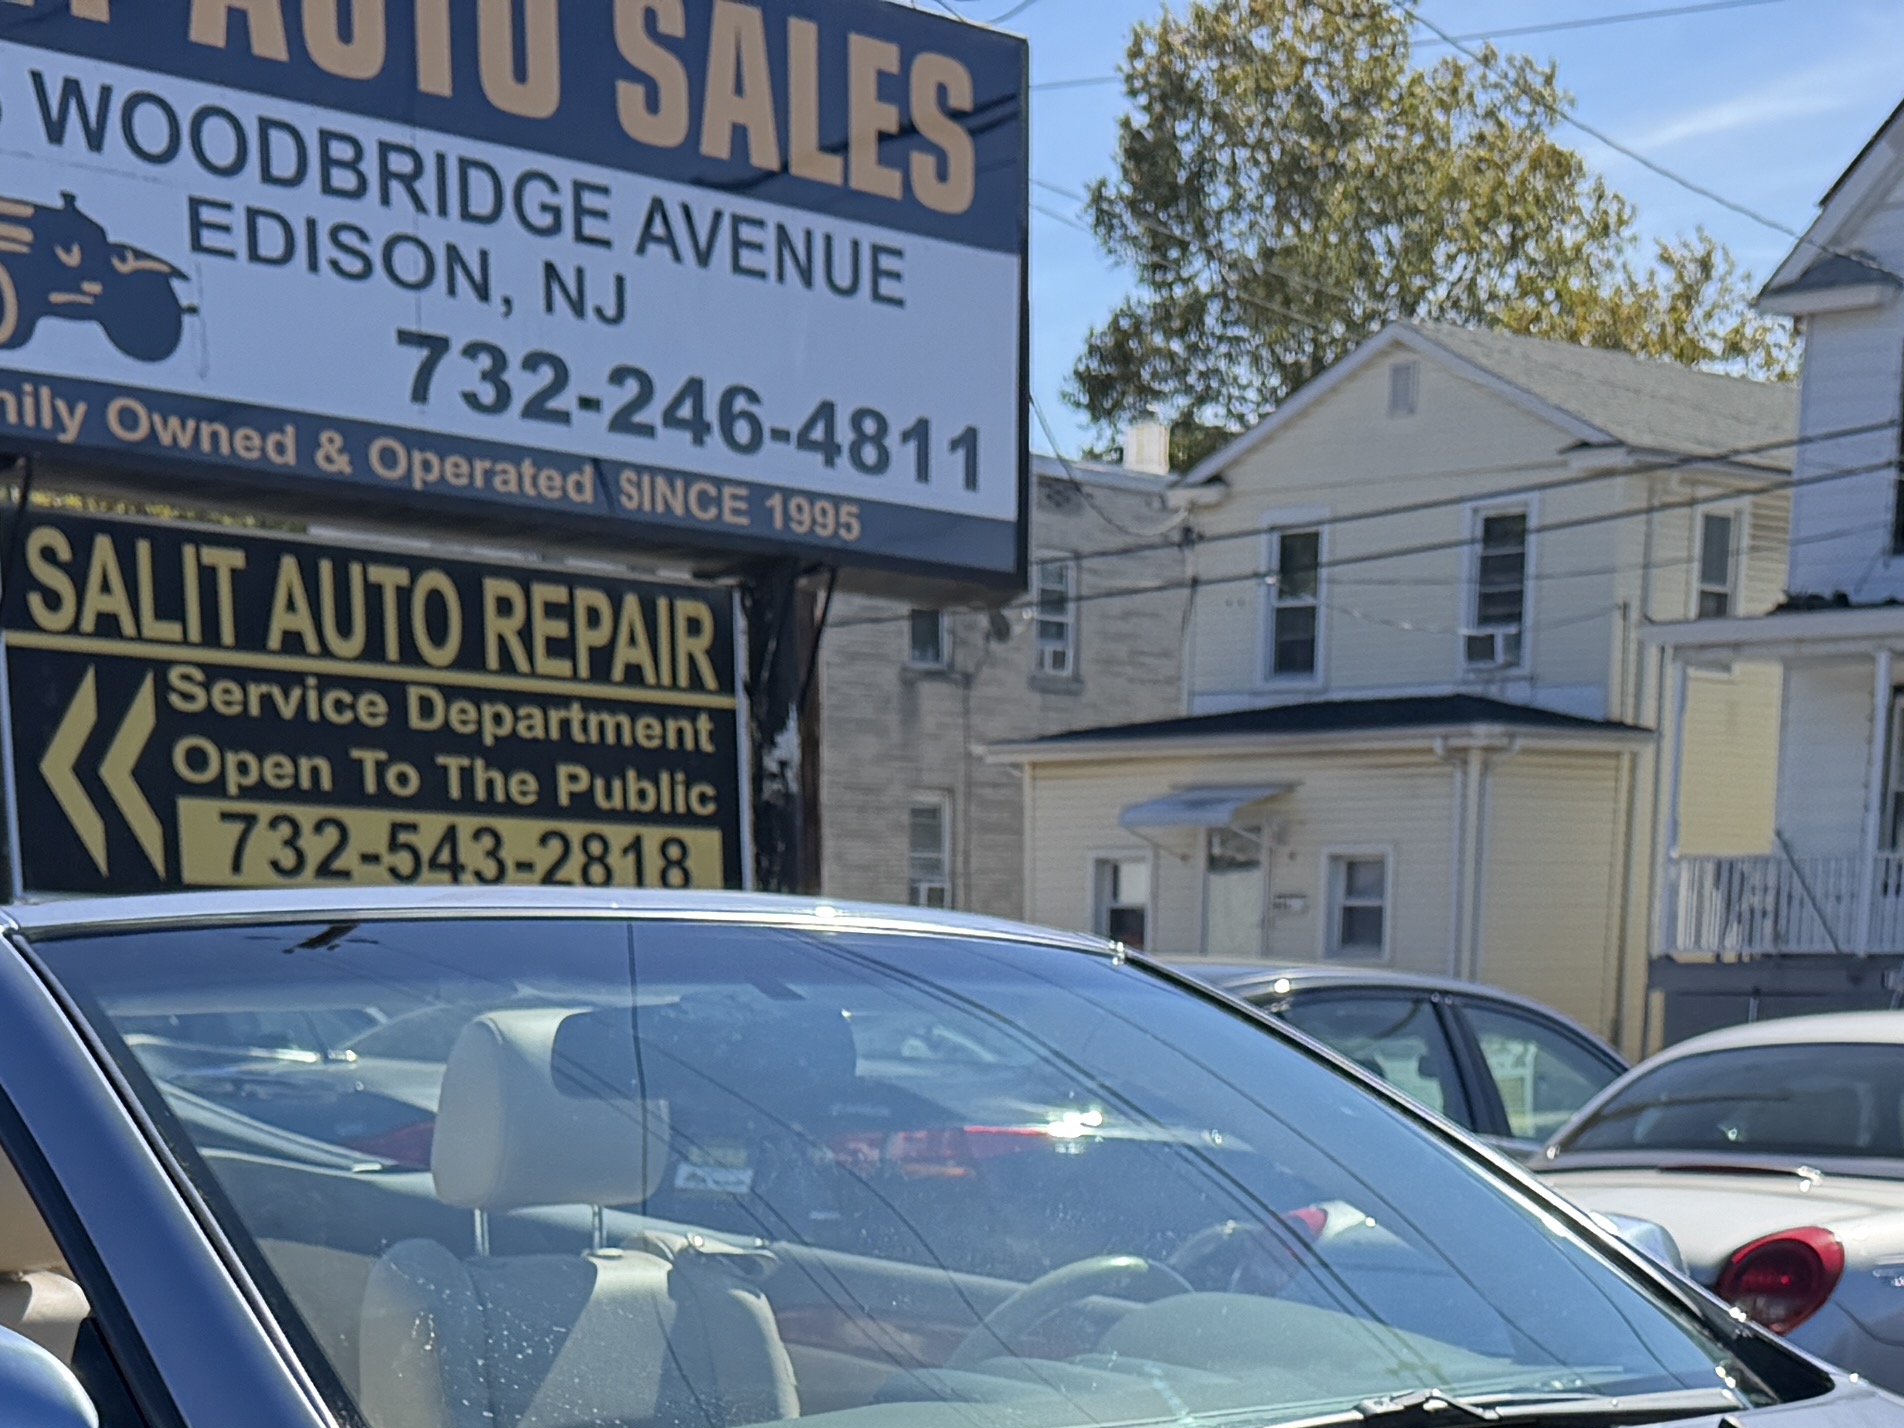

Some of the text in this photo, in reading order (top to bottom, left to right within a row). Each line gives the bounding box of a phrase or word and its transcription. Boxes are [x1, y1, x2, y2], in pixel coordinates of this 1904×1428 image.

[613, 0, 975, 214] SALES
[28, 69, 613, 252] WOODBRIDGE
[635, 195, 907, 309] AVENUE
[188, 195, 628, 325] EDISON, NJ
[106, 395, 296, 466] Owned
[314, 429, 353, 476] &
[367, 435, 595, 504] Operated
[618, 466, 752, 527] SINCE
[765, 493, 862, 542] 1995
[395, 327, 981, 493] 732-246-4811
[24, 525, 720, 691] SALIT AUTO REPAIR
[165, 662, 716, 755] Service Department
[172, 734, 718, 817] Open To The Public
[217, 810, 693, 888] 732-543-2818
